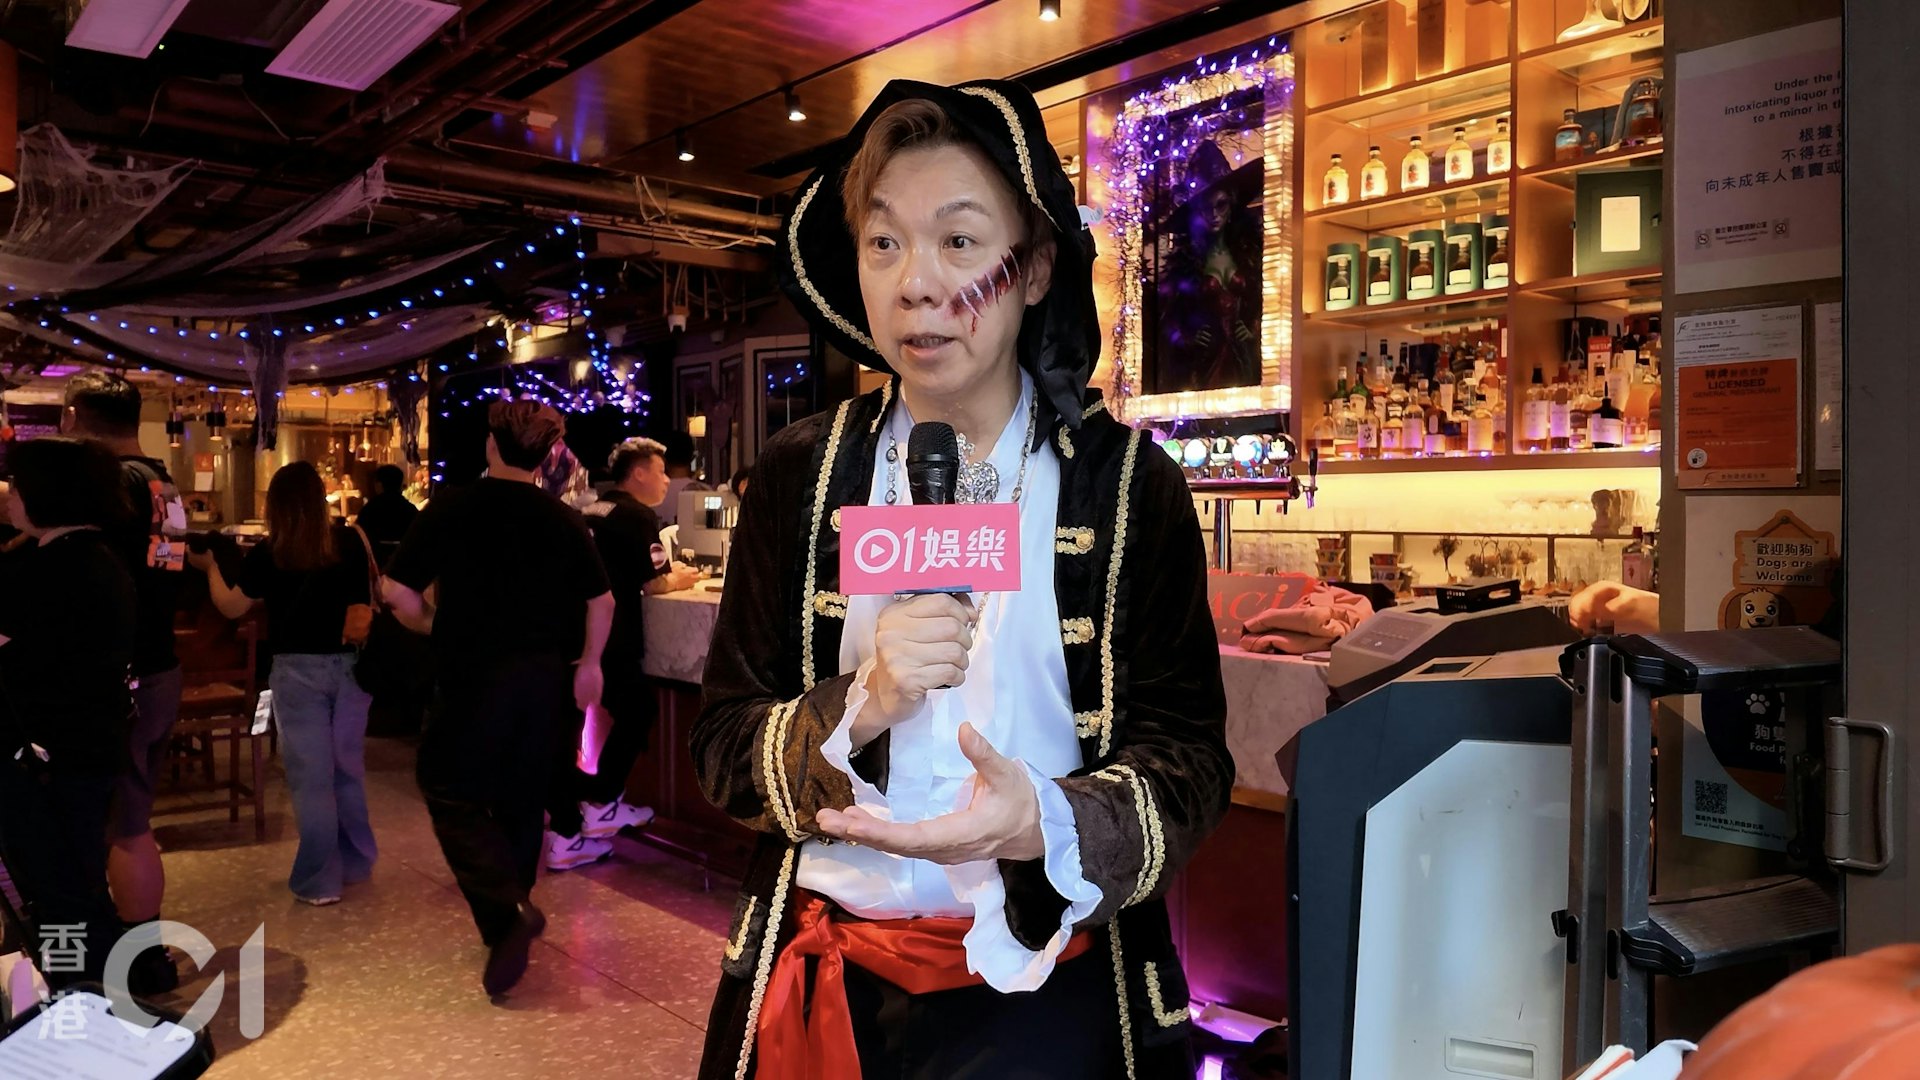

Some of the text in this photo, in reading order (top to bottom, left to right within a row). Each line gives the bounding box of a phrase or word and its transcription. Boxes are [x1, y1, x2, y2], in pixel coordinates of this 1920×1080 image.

[1774, 75, 1810, 91] Under
[1813, 73, 1833, 84] the
[1724, 95, 1790, 116] intoxicating
[1795, 89, 1828, 103] liquor
[1753, 113, 1765, 124] to
[1768, 112, 1776, 121] a
[1779, 104, 1813, 119] minor
[1817, 101, 1828, 113] in
[1708, 378, 1766, 390] LICENSED
[1756, 543, 1813, 556] 歡迎狗狗
[1757, 558, 1787, 569] Dogs
[1756, 571, 1813, 582] Welcome
[1750, 742, 1776, 753] Food
